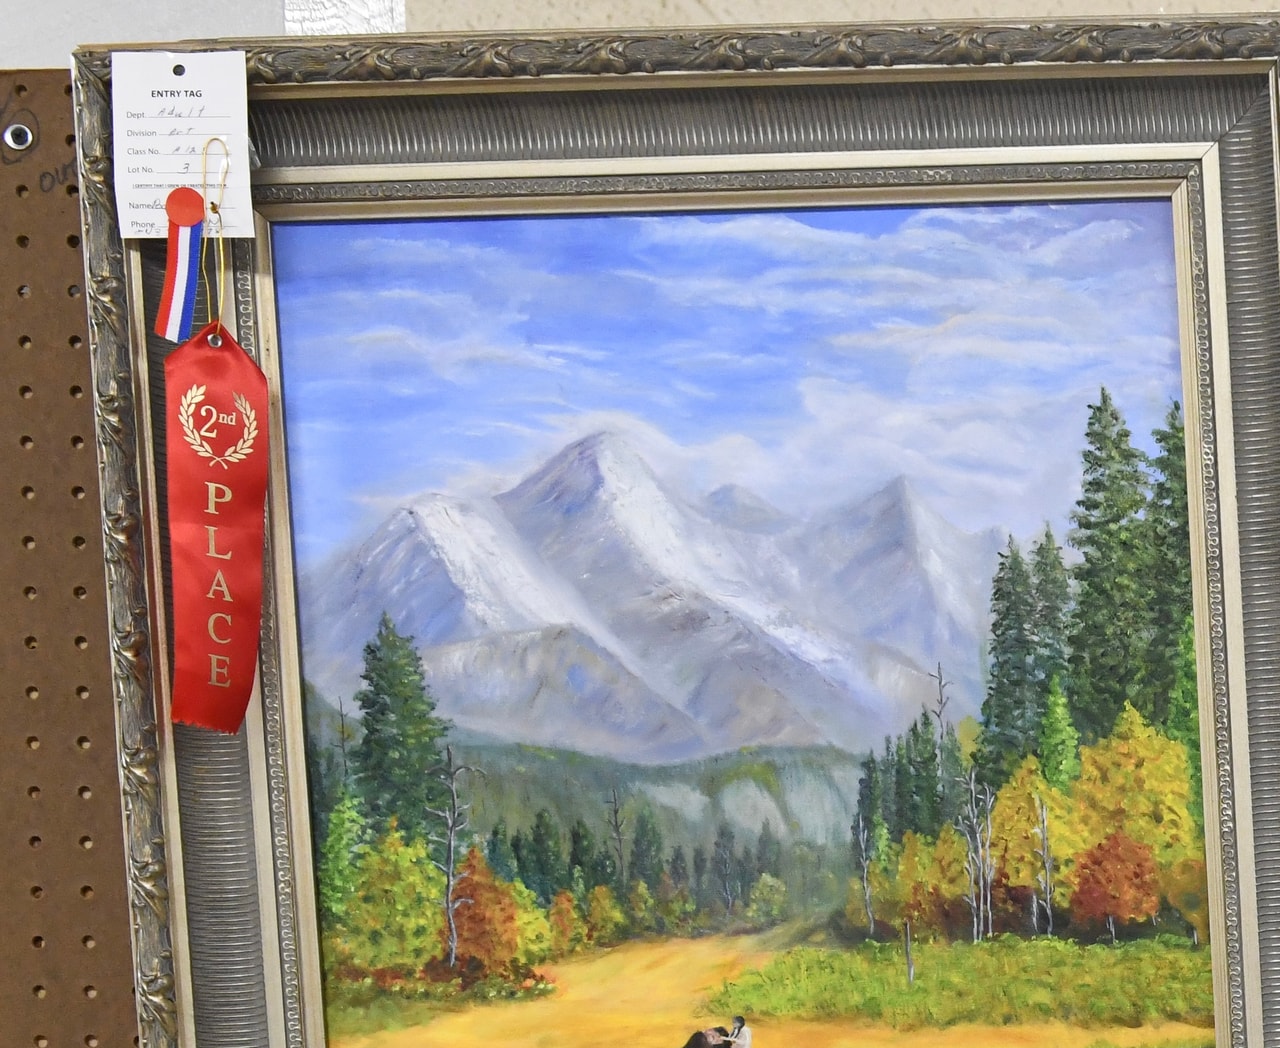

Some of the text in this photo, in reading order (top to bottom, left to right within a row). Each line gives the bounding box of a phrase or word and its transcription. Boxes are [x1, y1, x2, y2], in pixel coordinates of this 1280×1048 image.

[151, 89, 203, 98] ENTRY TAG
[126, 129, 157, 137] Division
[130, 221, 156, 230] Phone
[199, 404, 237, 439] 2nd
[203, 481, 233, 689] PLACE
